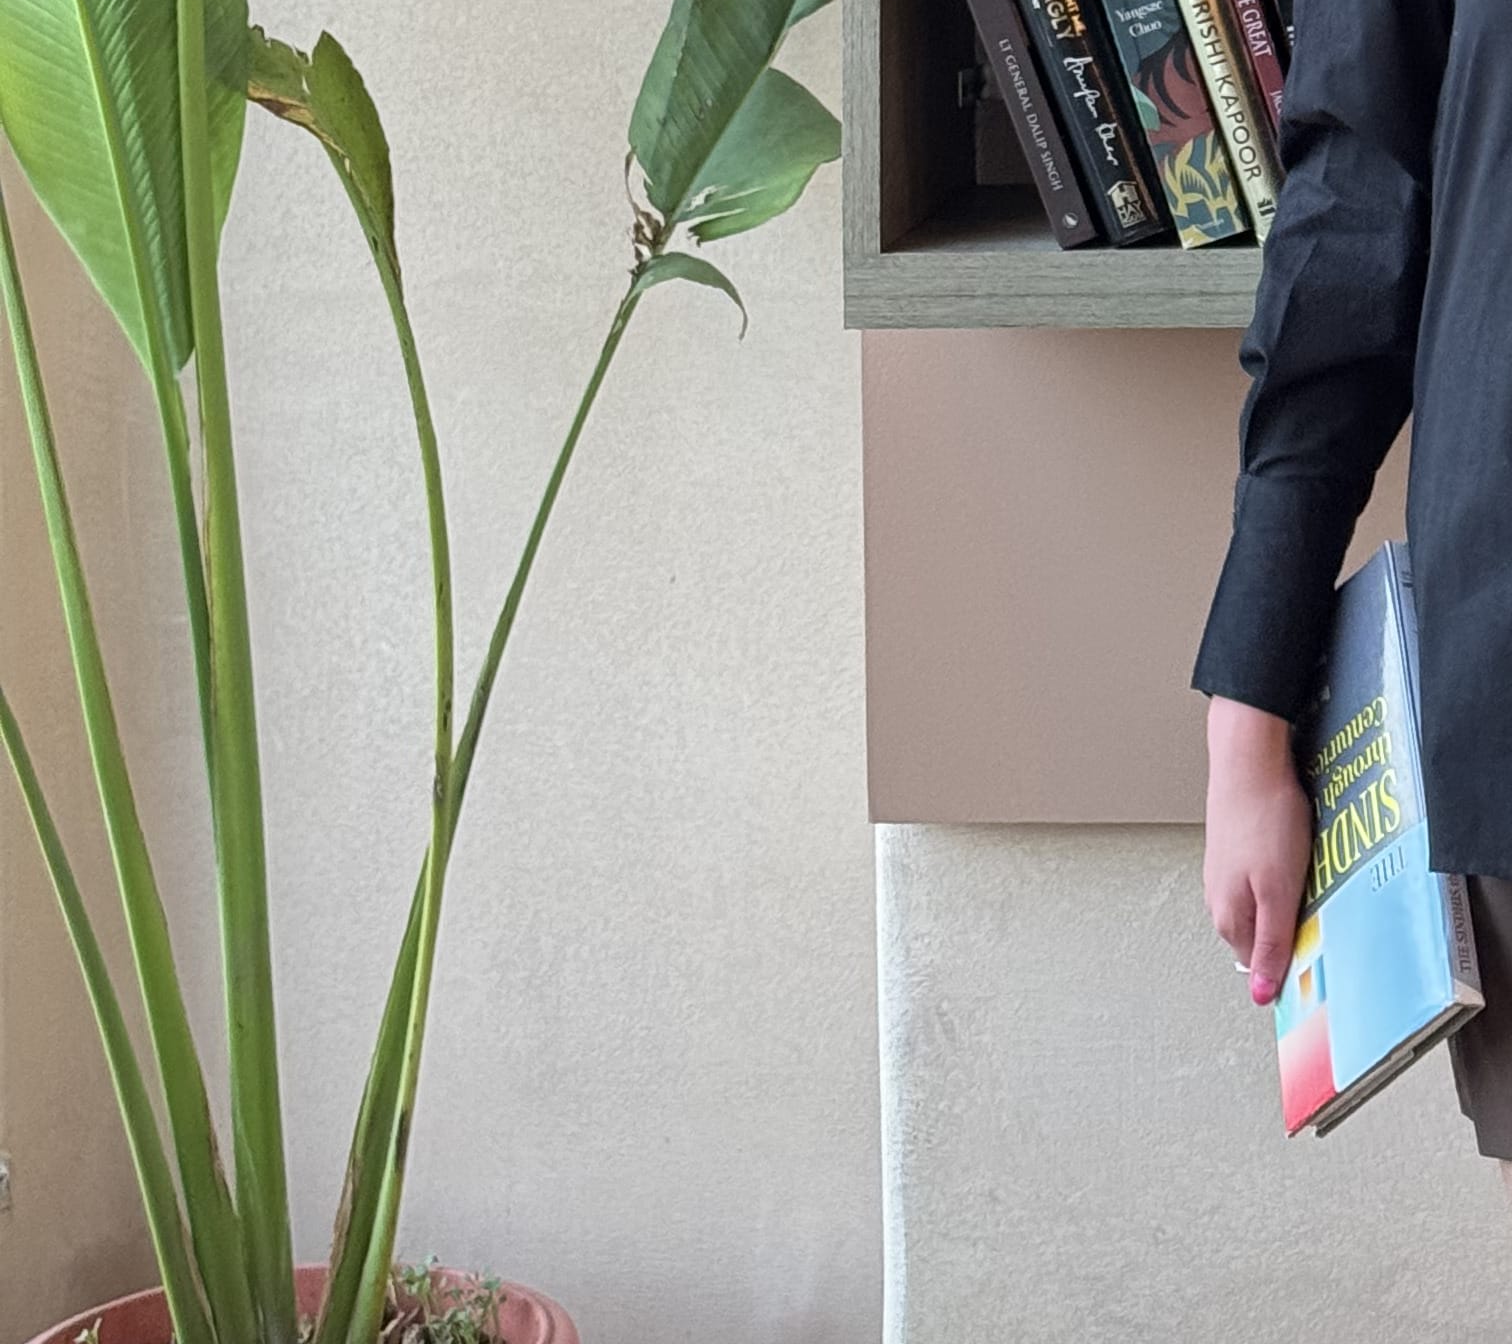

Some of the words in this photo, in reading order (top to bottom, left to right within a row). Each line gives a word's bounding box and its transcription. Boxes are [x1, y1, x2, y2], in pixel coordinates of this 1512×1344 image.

[998, 39, 1011, 52] LT
[1236, 8, 1272, 59] GREAT
[1002, 54, 1037, 111] GENERAL
[1191, 0, 1232, 69] RISHI
[1215, 75, 1262, 182] KAPOOR
[1025, 114, 1050, 149] DALIP
[1038, 150, 1064, 191] SINGH
